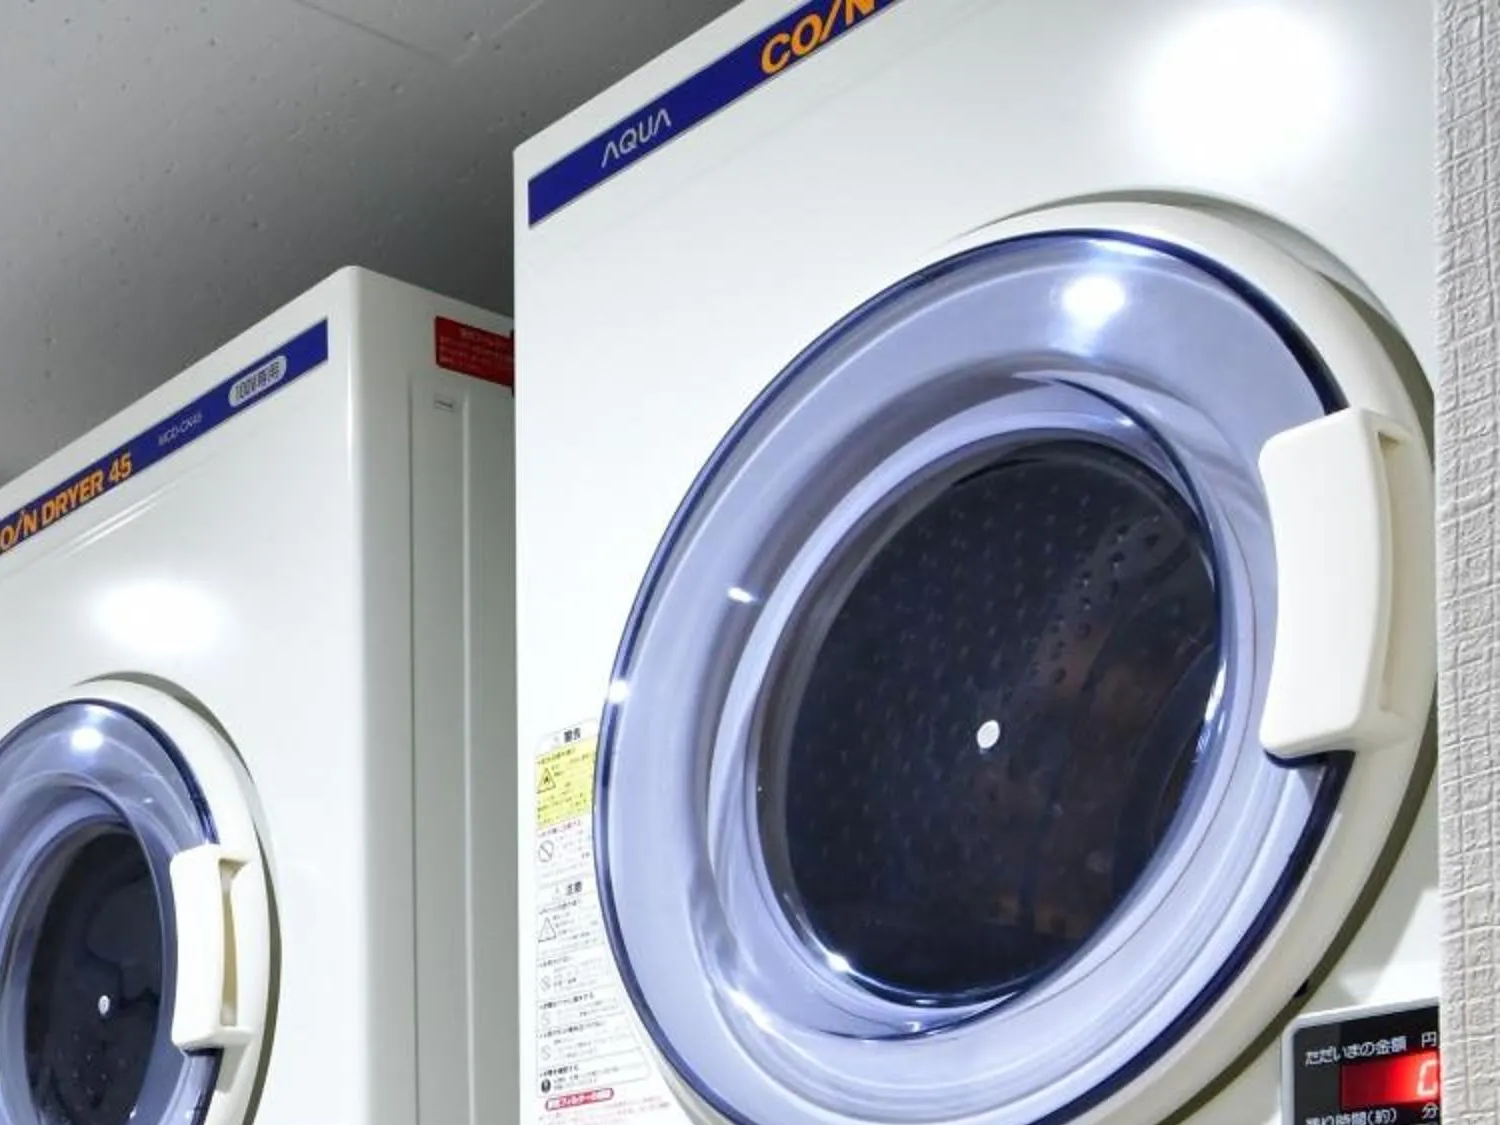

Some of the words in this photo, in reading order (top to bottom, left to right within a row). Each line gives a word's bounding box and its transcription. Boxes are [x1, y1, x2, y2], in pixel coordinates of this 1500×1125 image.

[601, 108, 672, 168] AQUA
[41, 468, 104, 526] DRYER
[108, 453, 133, 482] 45
[1305, 1036, 1407, 1067] ただいまの金額
[1421, 1031, 1437, 1048] 円
[1421, 1102, 1438, 1120] 分
